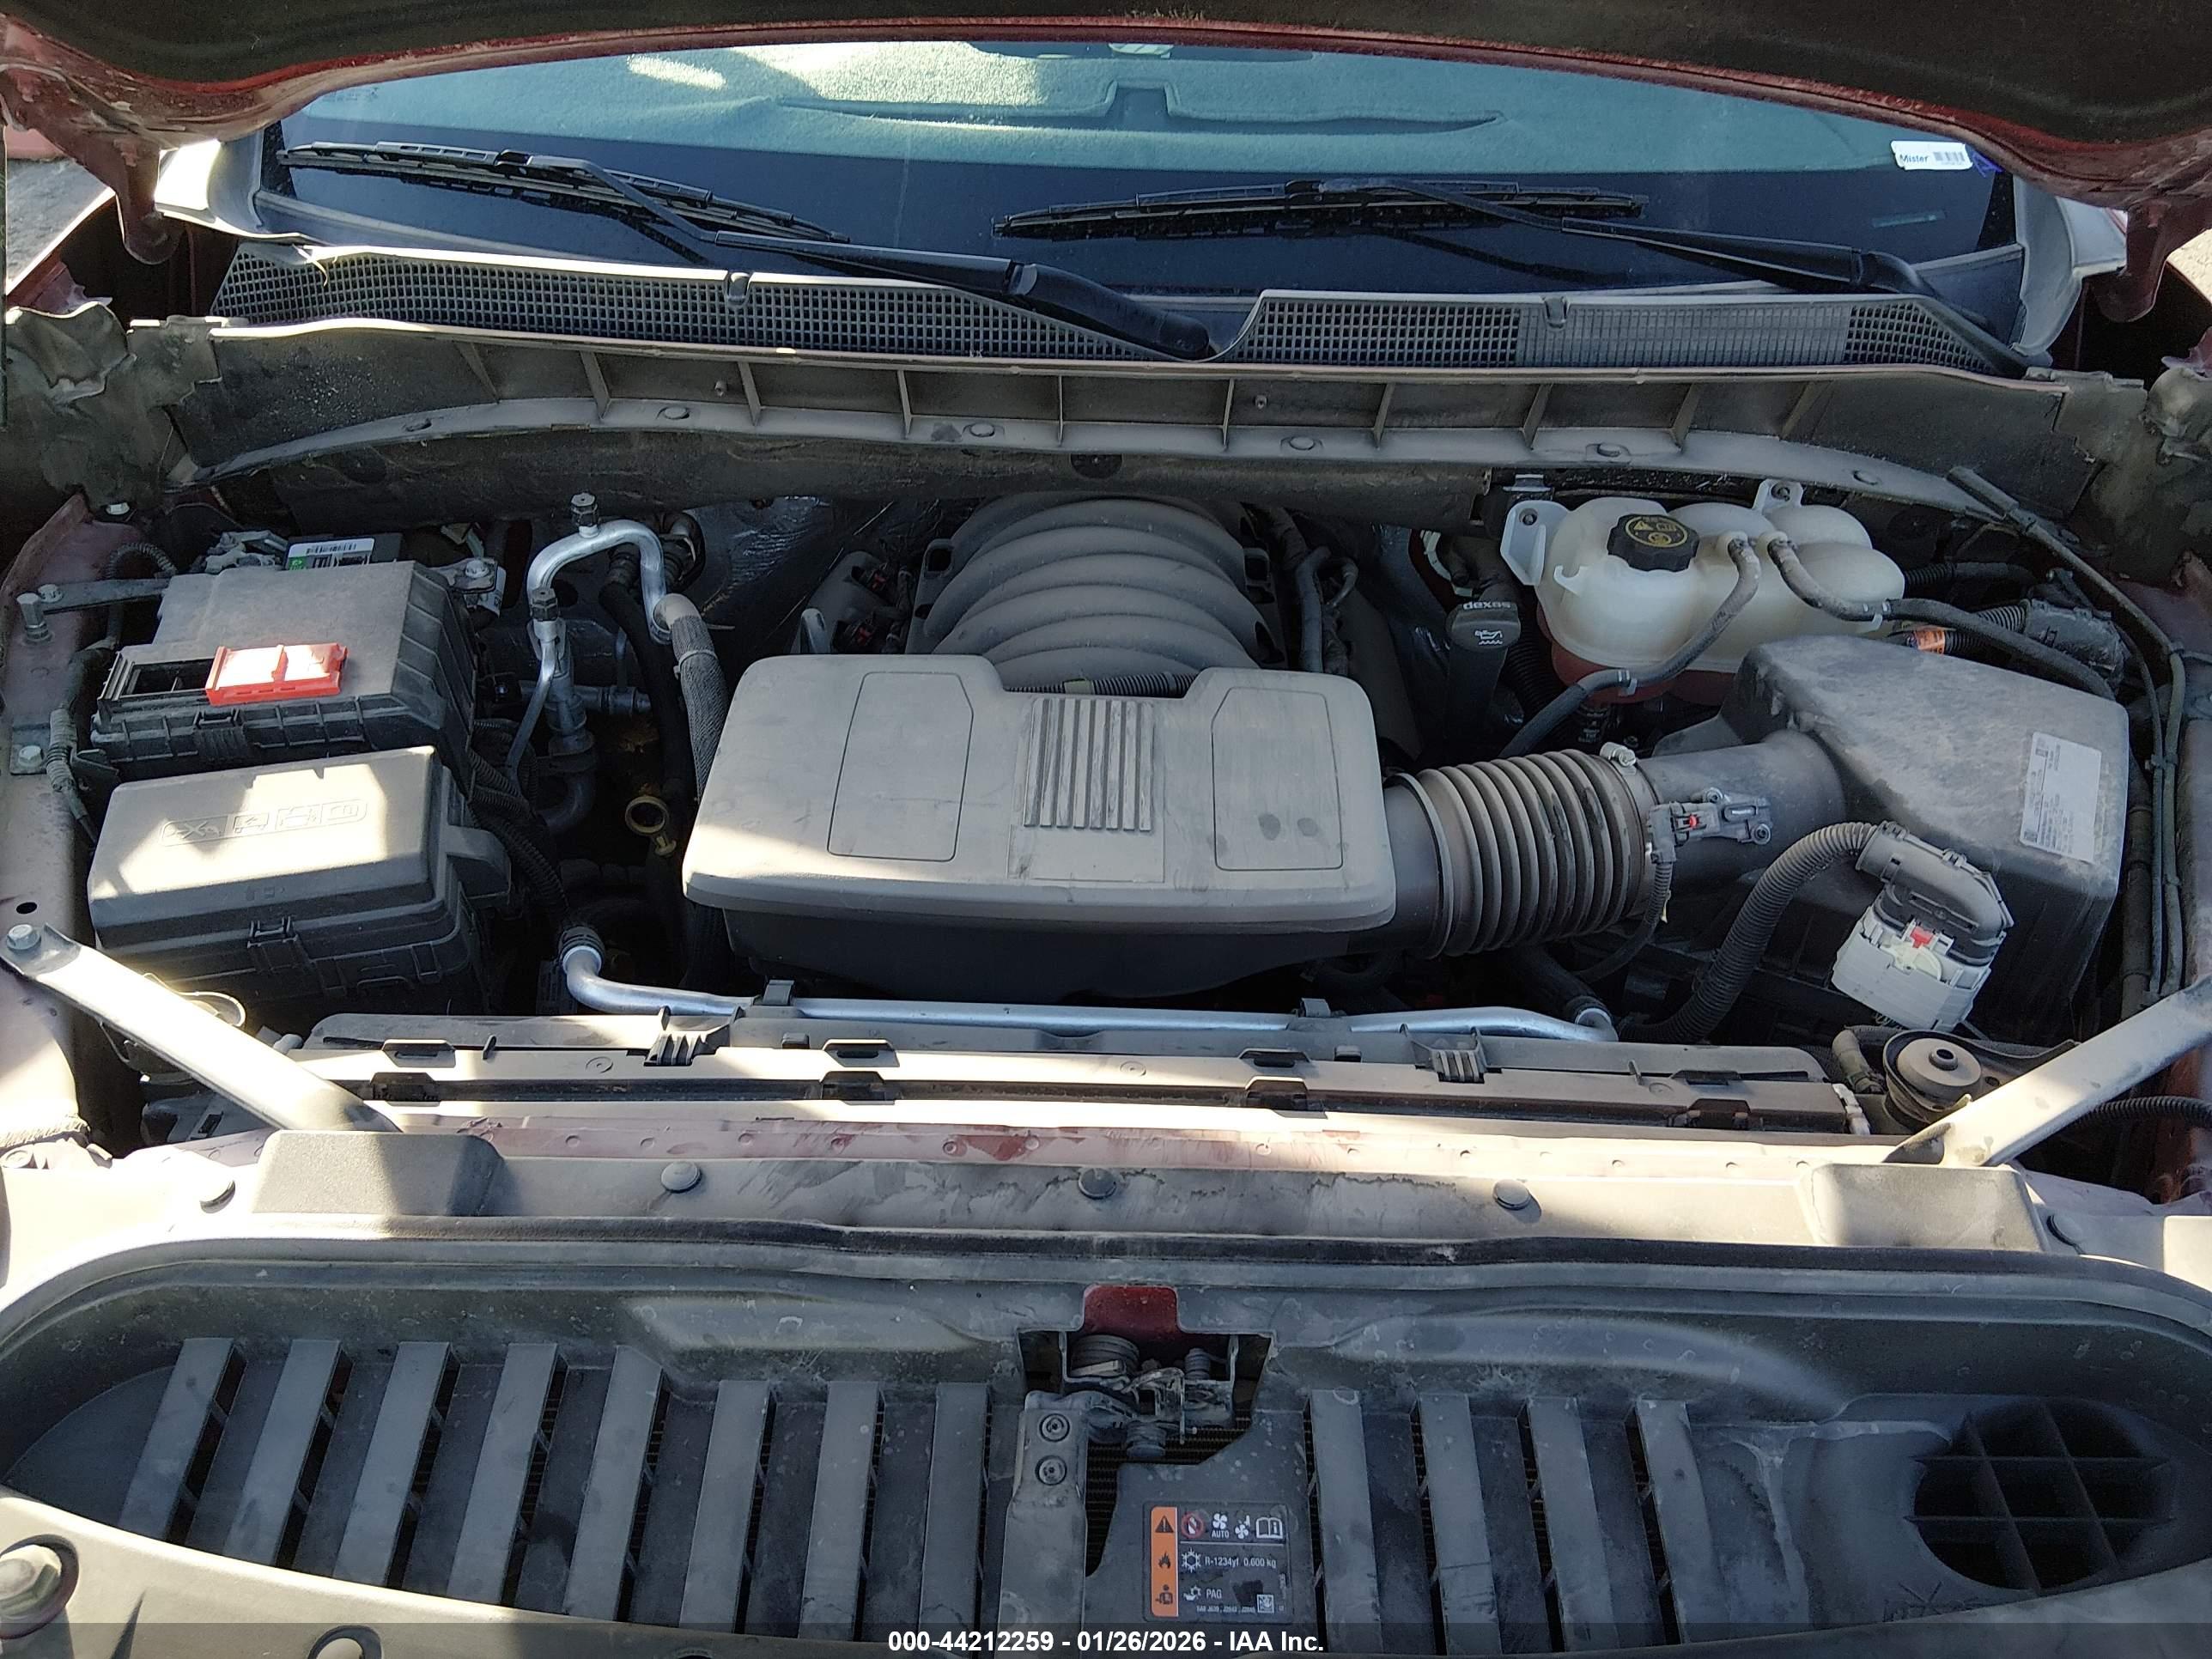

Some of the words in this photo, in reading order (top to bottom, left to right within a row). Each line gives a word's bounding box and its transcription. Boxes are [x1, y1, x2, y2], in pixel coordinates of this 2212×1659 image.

[1462, 601, 1510, 610] dexos
[1212, 1530, 1230, 1540] AUTO
[1205, 1556, 1239, 1569] R-1234yf
[1267, 1558, 1277, 1570] kg
[1206, 1589, 1222, 1599] PAG
